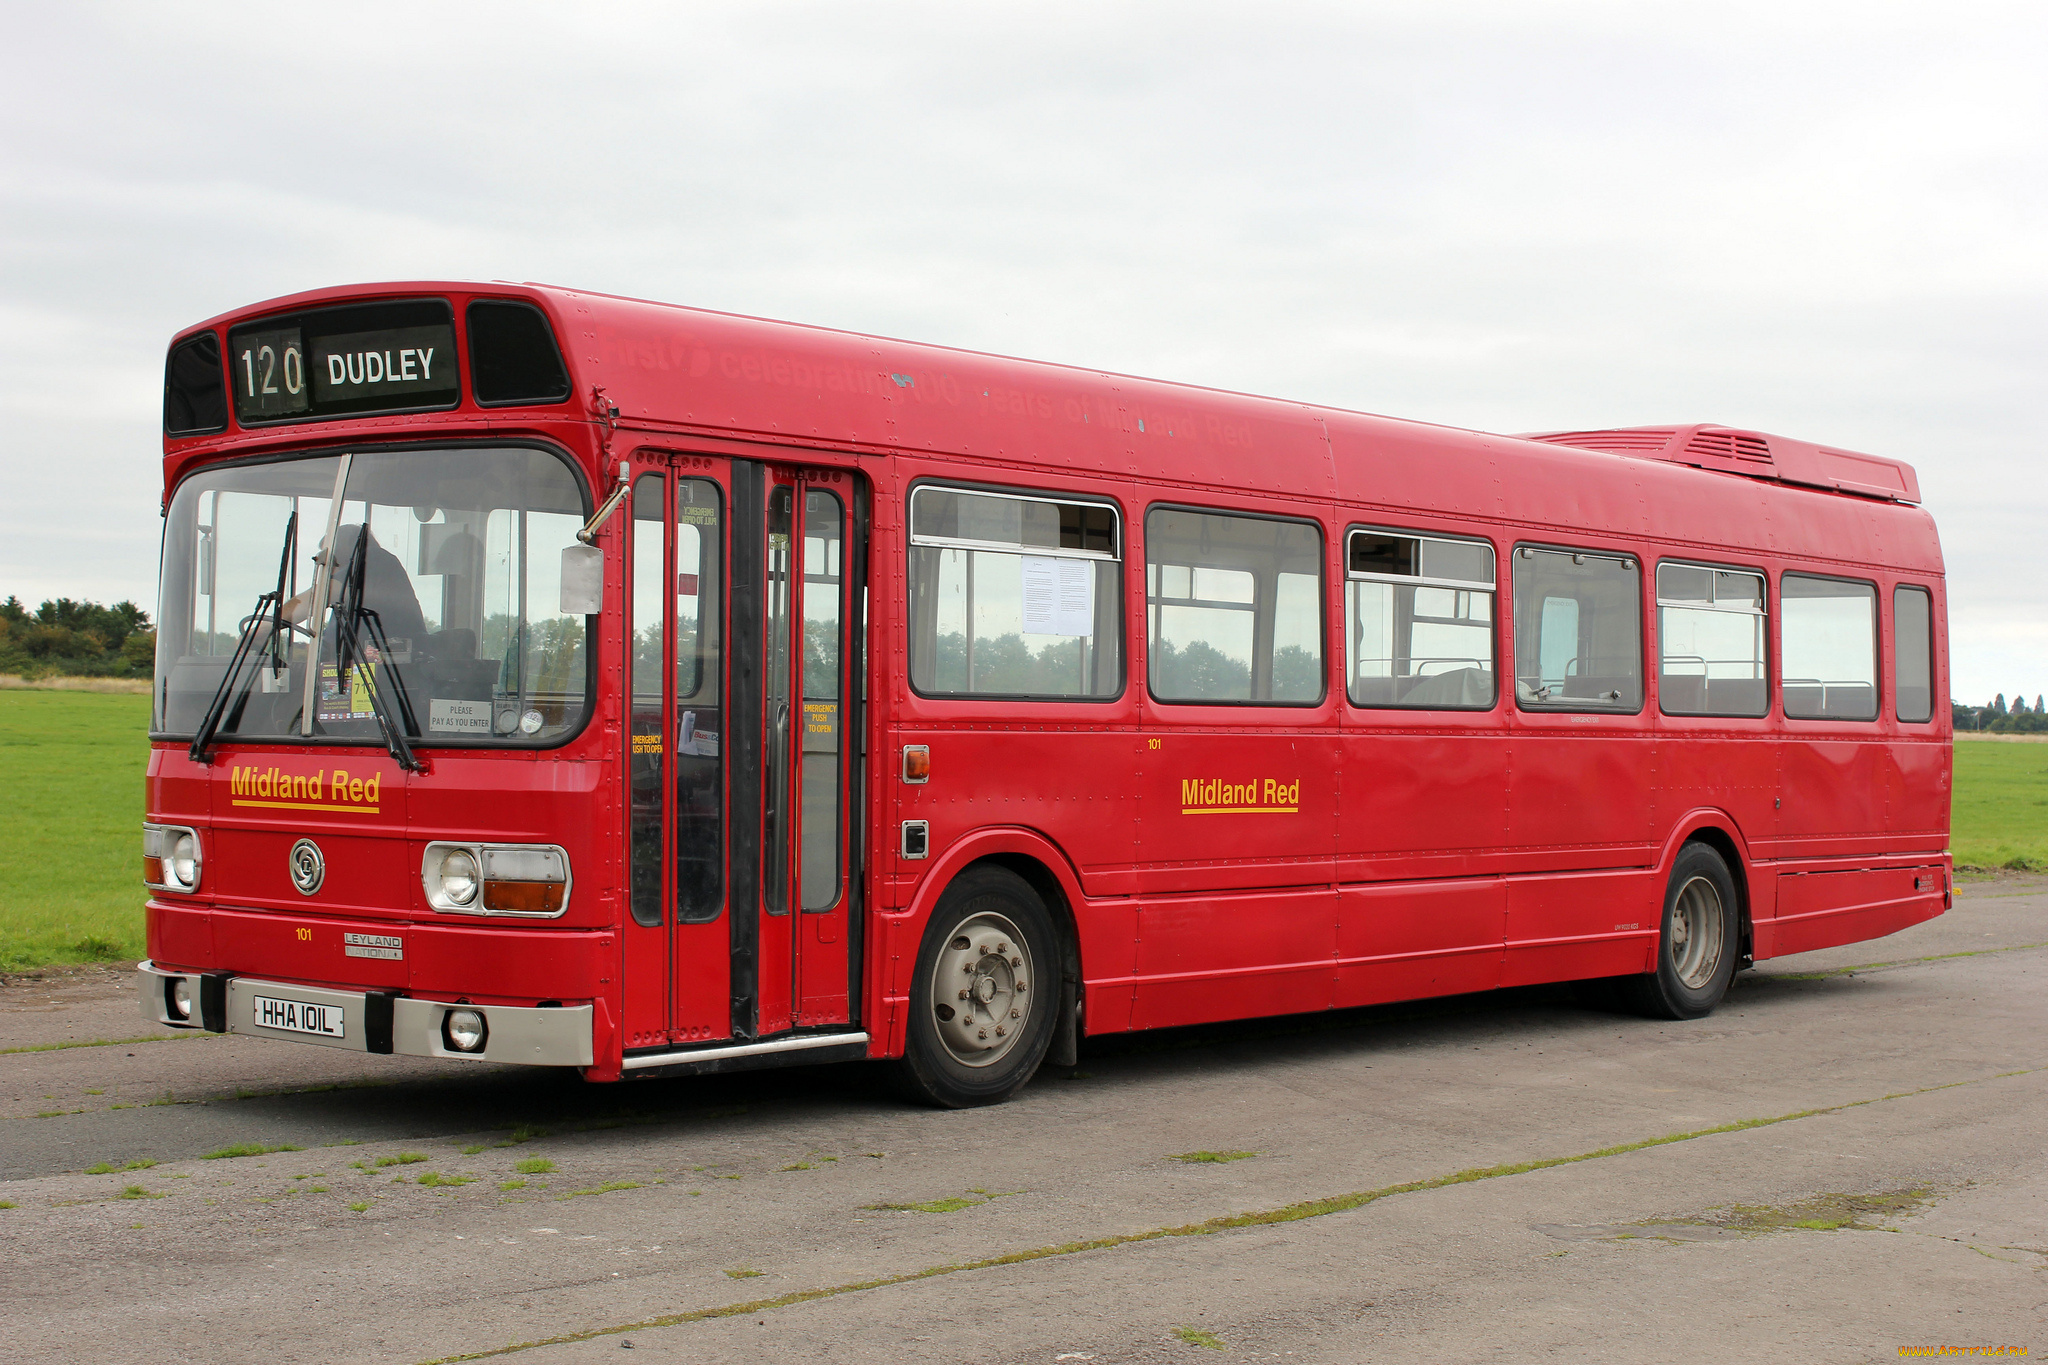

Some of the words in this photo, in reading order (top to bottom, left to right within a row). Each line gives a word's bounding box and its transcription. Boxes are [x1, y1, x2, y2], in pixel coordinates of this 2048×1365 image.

[241, 345, 301, 397] 120
[327, 347, 434, 385] DUDLEY
[449, 706, 473, 715] PLEASE
[804, 704, 838, 712] EMERGENCY
[431, 717, 444, 725] PAY
[446, 718, 454, 726] AS
[455, 718, 467, 727] YOU
[469, 719, 490, 727] ENTER
[812, 713, 828, 722] PUSH
[808, 724, 816, 733] TO
[817, 724, 832, 733] OPEN
[632, 735, 662, 744] EMERGENCY
[1147, 738, 1161, 750] 101
[231, 766, 324, 800] Midland
[331, 770, 381, 803] Red
[1181, 778, 1258, 805] Midland
[1263, 778, 1300, 804] Red
[296, 927, 312, 941] 101
[345, 933, 401, 947] LEYLAND
[263, 1000, 297, 1028] HHA
[301, 1005, 334, 1033] 101L
